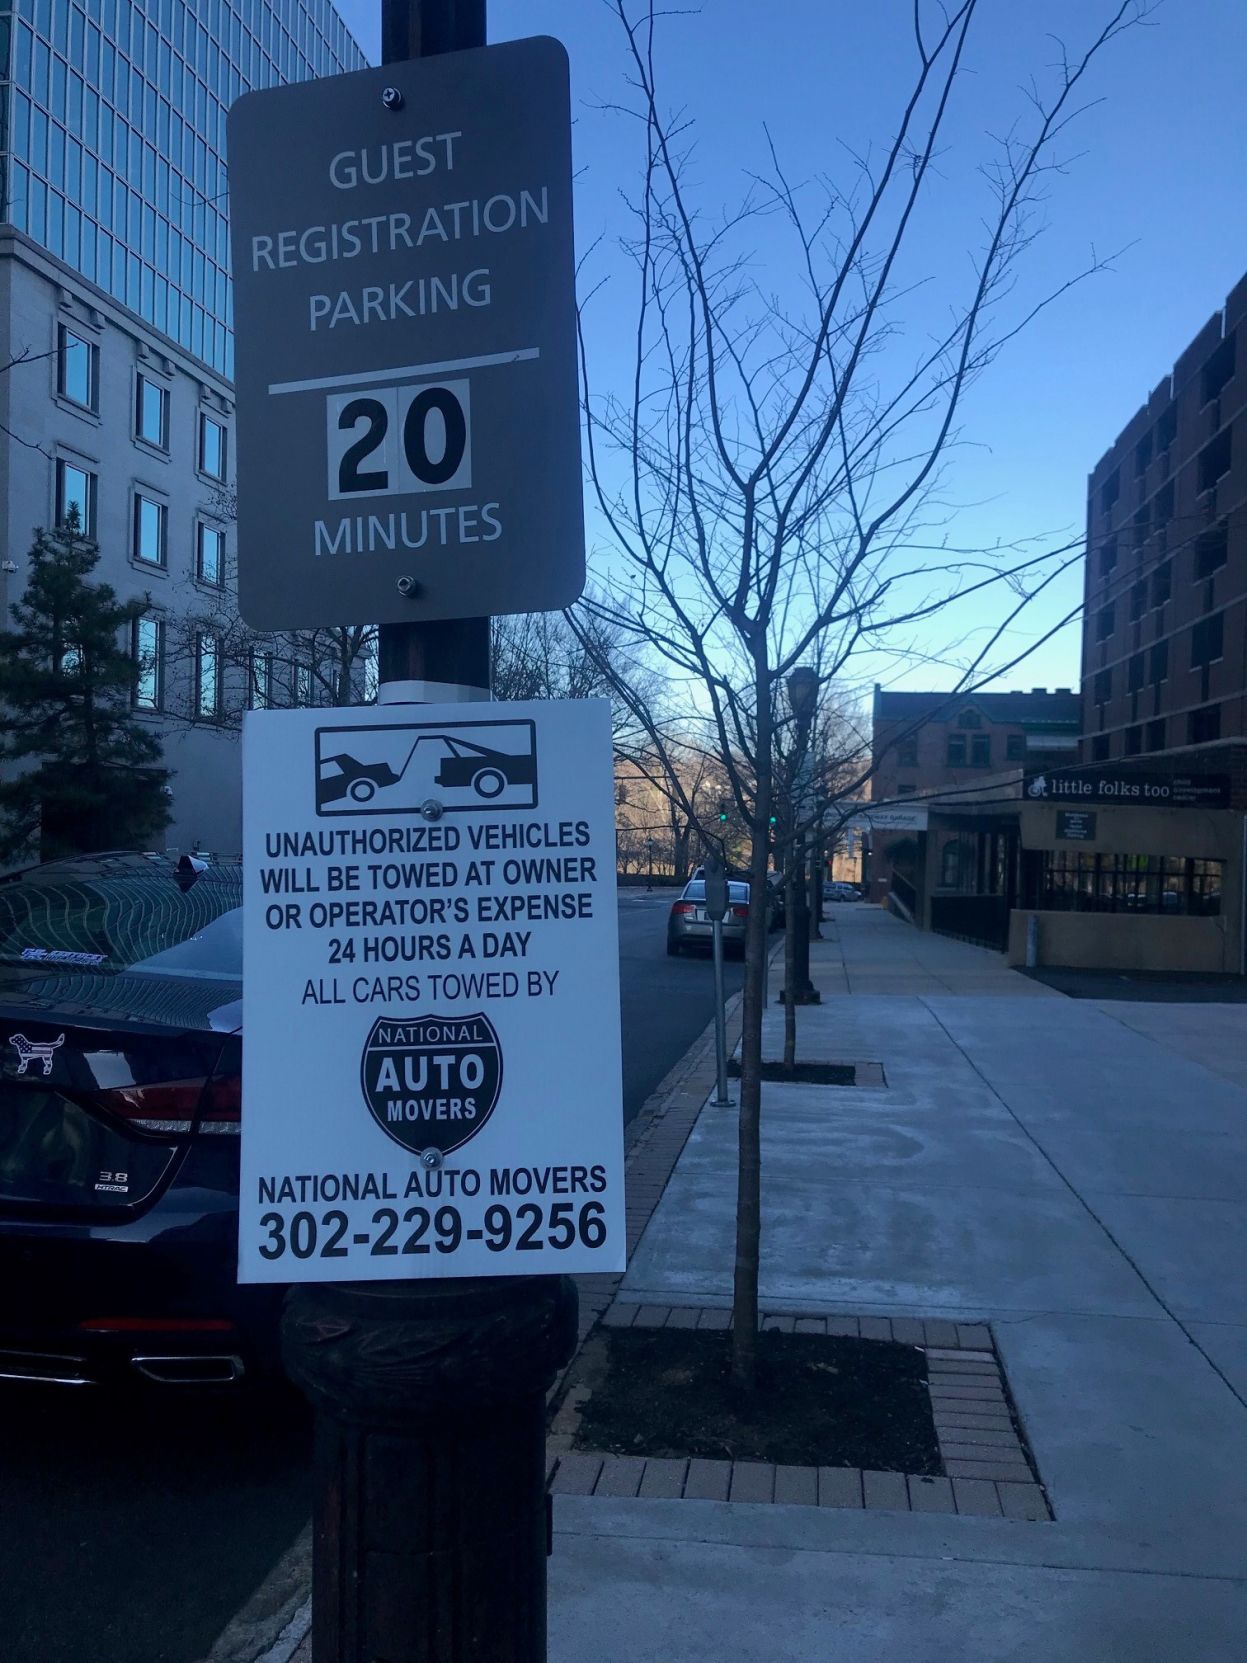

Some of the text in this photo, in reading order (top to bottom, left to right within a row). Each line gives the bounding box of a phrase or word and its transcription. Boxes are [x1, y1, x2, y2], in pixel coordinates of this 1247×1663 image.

[329, 131, 463, 189] GUEST
[251, 187, 549, 272] REGISTRATION
[310, 269, 492, 331] PARKING
[337, 387, 467, 493] 20
[314, 503, 503, 556] MINUTES
[1052, 779, 1169, 798] little folks too
[266, 822, 590, 857] UNAUTHORIZED VEHICLES
[260, 857, 597, 894] WILL BE TOWED AT OWNER
[266, 893, 593, 929] OR OPERATOR'S EXPENSE
[328, 931, 531, 964] 24 HOURS A DAY
[301, 970, 559, 1005] ALL CARS TOWED BY
[379, 1024, 483, 1043] NATIONAL
[375, 1053, 485, 1093] AUTO
[387, 1098, 476, 1122] MOVERS
[99, 1171, 128, 1183] 3.8
[259, 1164, 607, 1204] NATIONAL AUTO MOVERS
[259, 1201, 607, 1260] 302-229-9256
